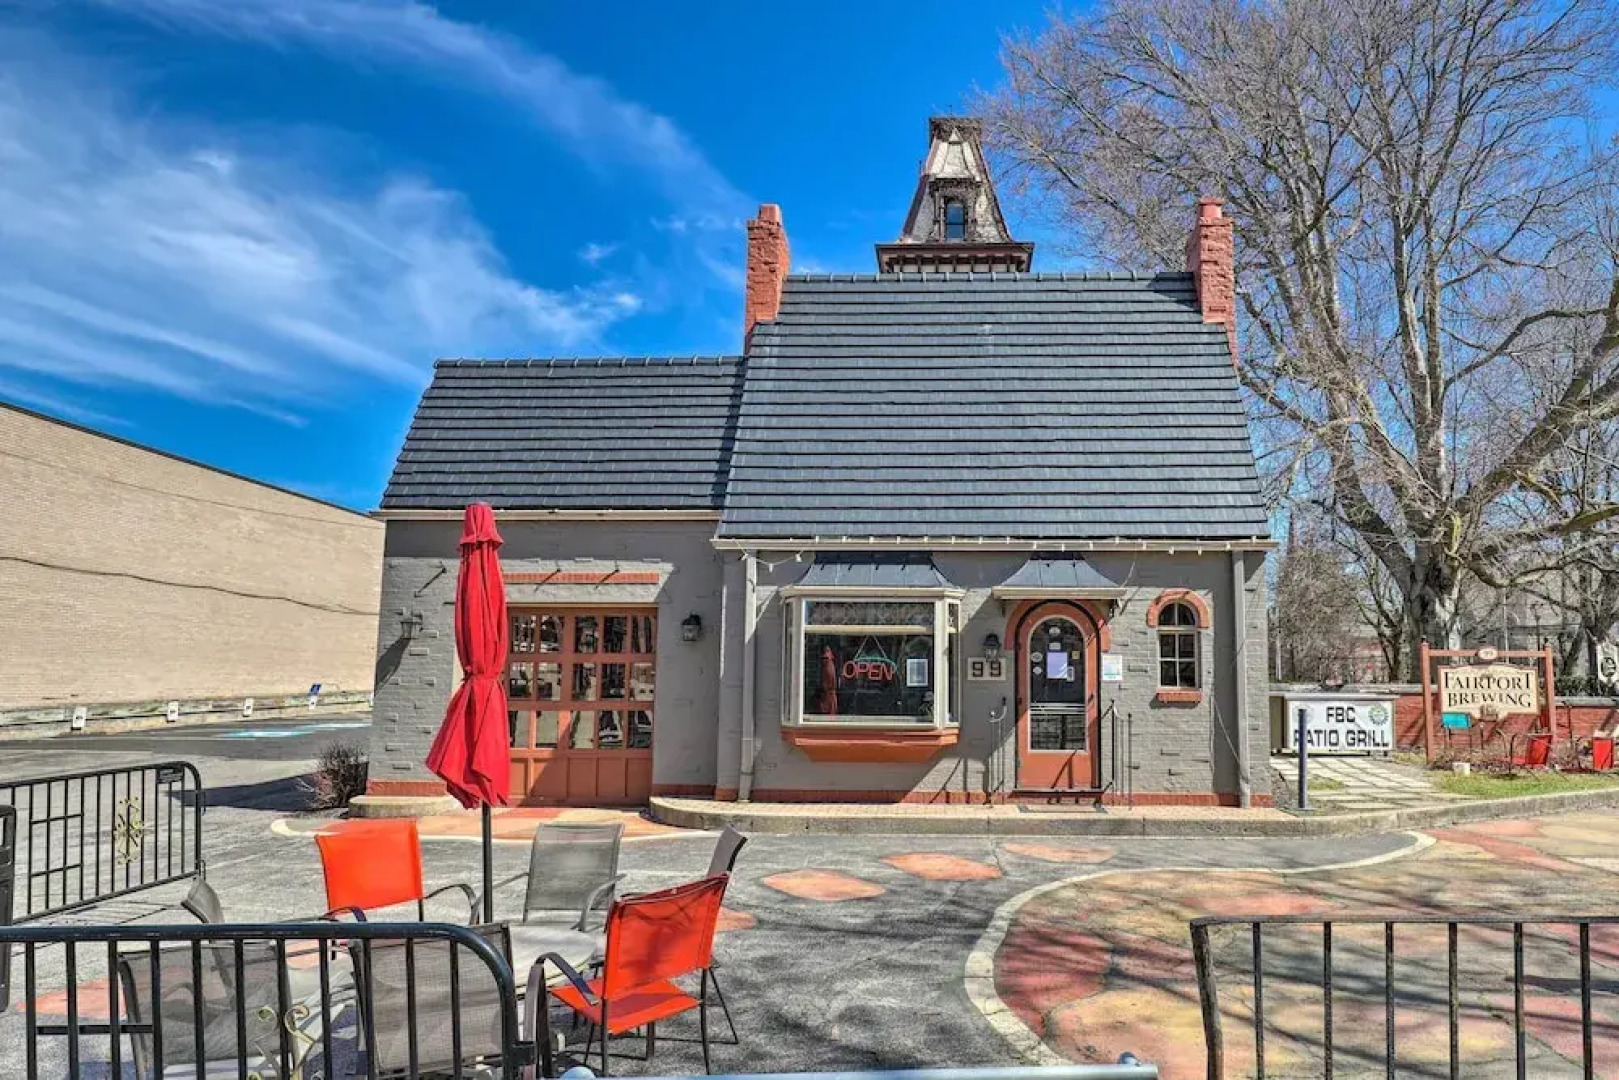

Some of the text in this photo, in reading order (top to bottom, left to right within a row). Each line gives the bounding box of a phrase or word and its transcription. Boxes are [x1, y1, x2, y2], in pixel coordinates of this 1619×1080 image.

[842, 660, 893, 680] OPEN
[972, 661, 1001, 677] 99
[1443, 671, 1534, 689] FAIRPORT
[1448, 692, 1531, 707] BREWING
[1326, 706, 1356, 722] FBC
[1345, 729, 1389, 747] GRILL
